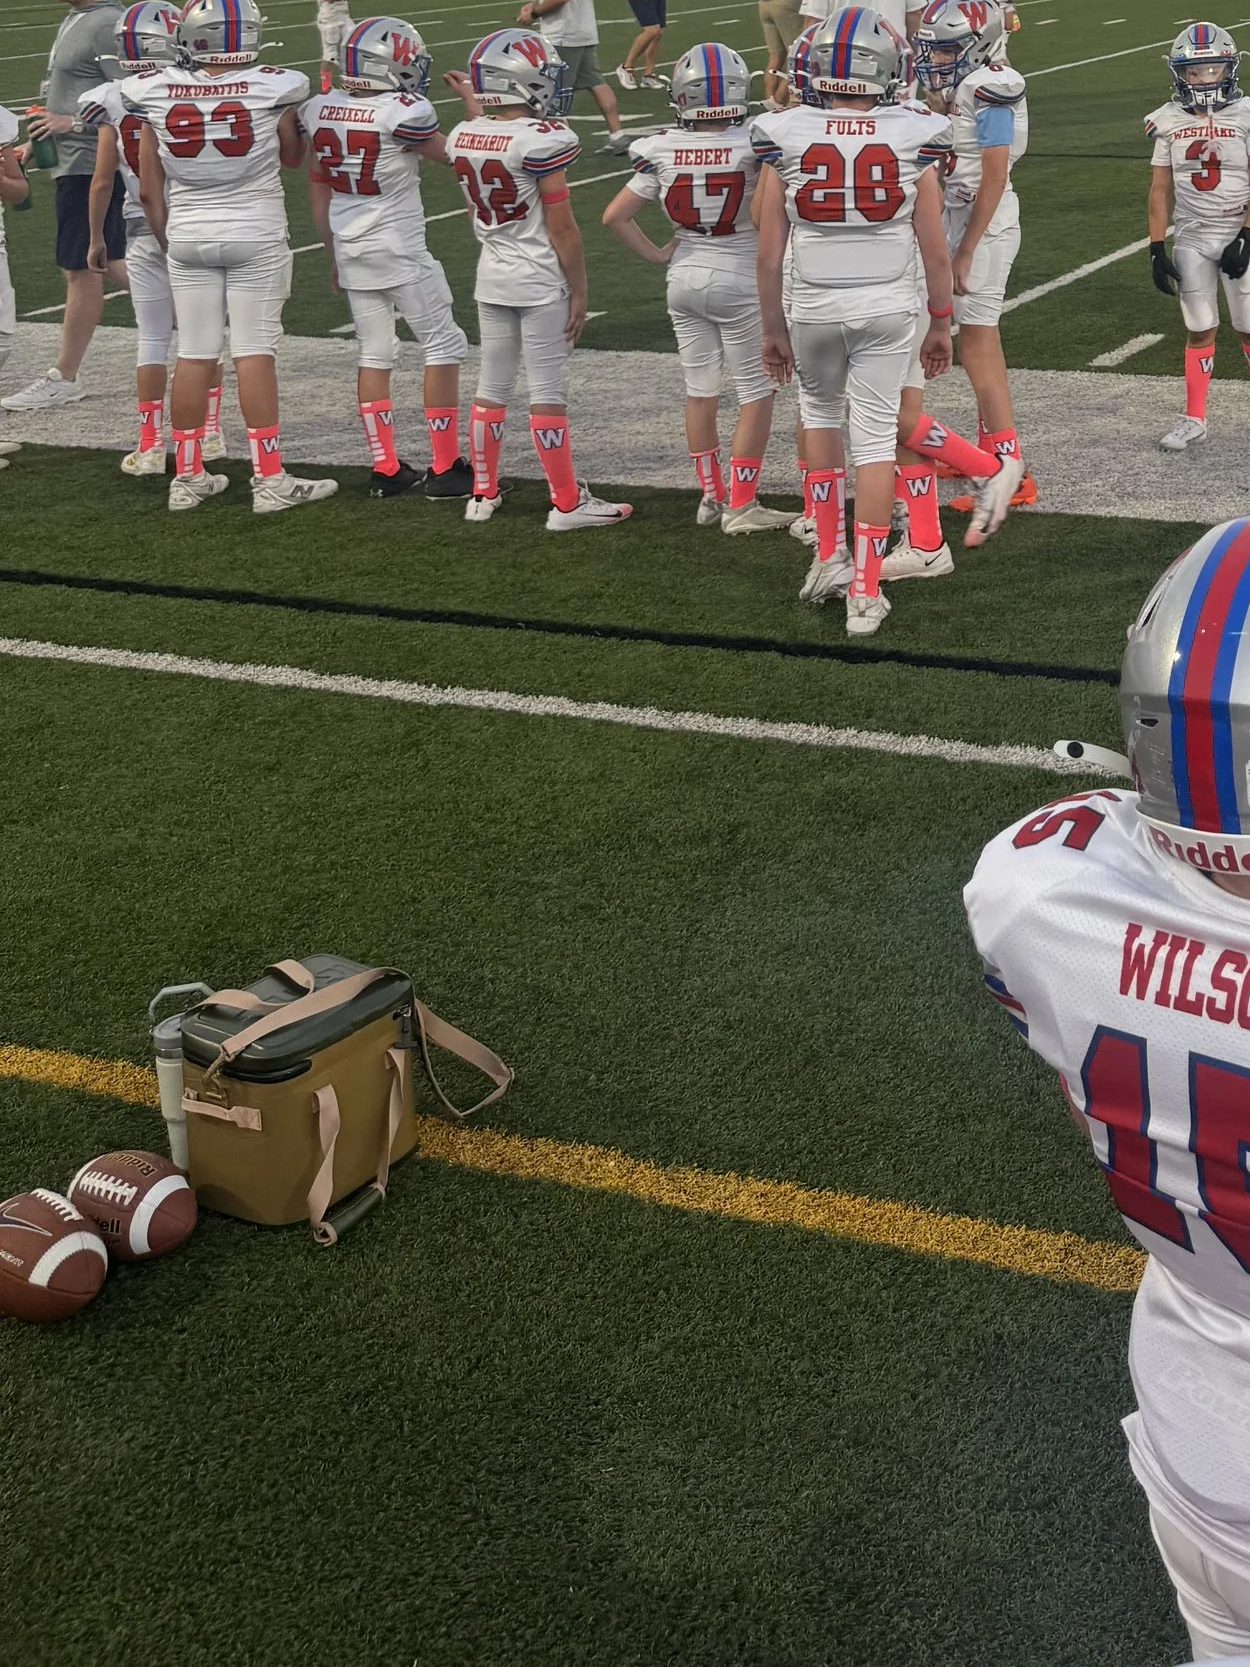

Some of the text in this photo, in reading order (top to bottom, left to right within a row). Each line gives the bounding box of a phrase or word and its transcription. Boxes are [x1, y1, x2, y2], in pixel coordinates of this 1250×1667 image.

[957, 1, 988, 32] W
[512, 36, 548, 69] W
[819, 80, 867, 94] Riddell
[696, 107, 738, 119] Riddell
[165, 101, 255, 159] 93
[825, 119, 876, 136] FULTS
[313, 127, 382, 196] 27
[673, 147, 733, 166] HEBERT
[1185, 140, 1222, 192] 3
[454, 156, 530, 227] 32
[794, 142, 906, 223] 28
[664, 170, 746, 237] 47
[427, 415, 451, 432] W
[536, 428, 565, 450] W
[736, 466, 758, 482] W
[810, 480, 832, 502] W
[906, 475, 932, 498] W
